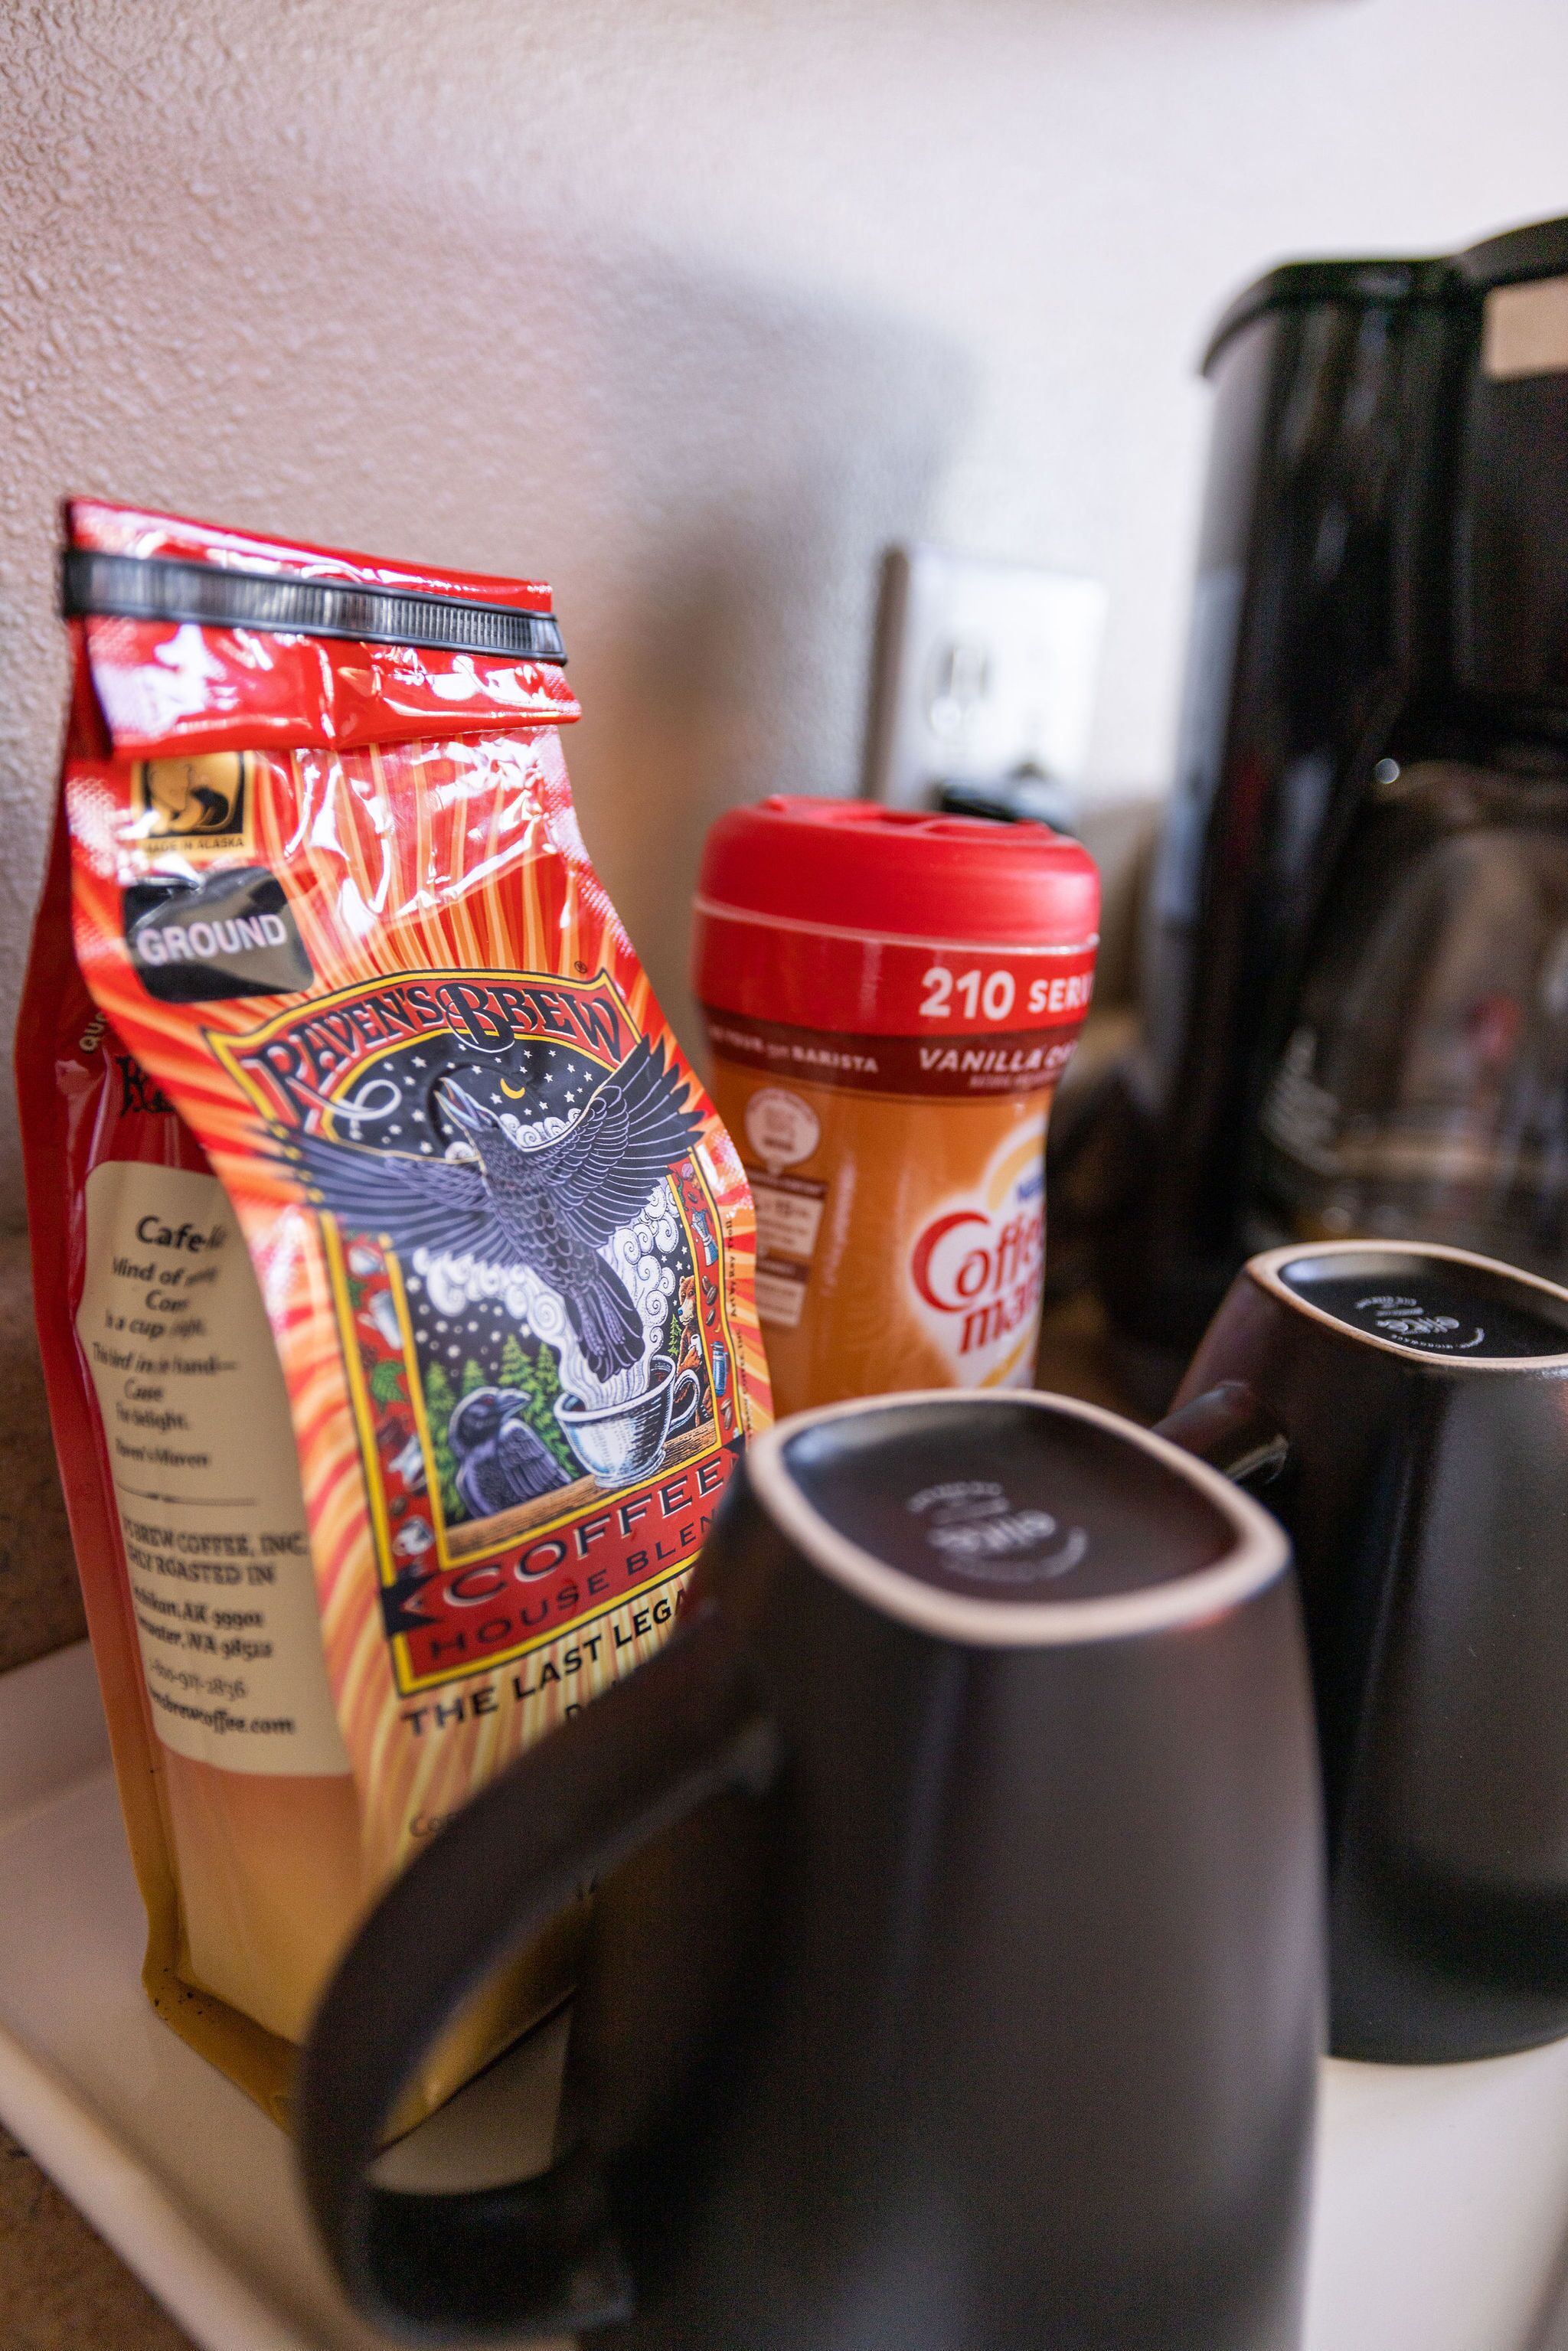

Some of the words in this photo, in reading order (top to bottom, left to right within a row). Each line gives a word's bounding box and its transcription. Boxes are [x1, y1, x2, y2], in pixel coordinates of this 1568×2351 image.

[136, 914, 287, 966] GROUND
[919, 966, 1016, 1021] 210
[240, 981, 446, 1135] RAVEN'S
[436, 982, 622, 1065] BREW
[792, 1046, 879, 1074] BARISTA
[919, 1047, 1043, 1072] VANILLA
[729, 1297, 737, 1318] Art
[443, 1456, 724, 1607] COFFEE
[430, 1569, 609, 1659] HOUSE
[626, 1508, 716, 1577] BLEN
[401, 1687, 498, 1736] THE
[514, 1634, 601, 1700] LAST
